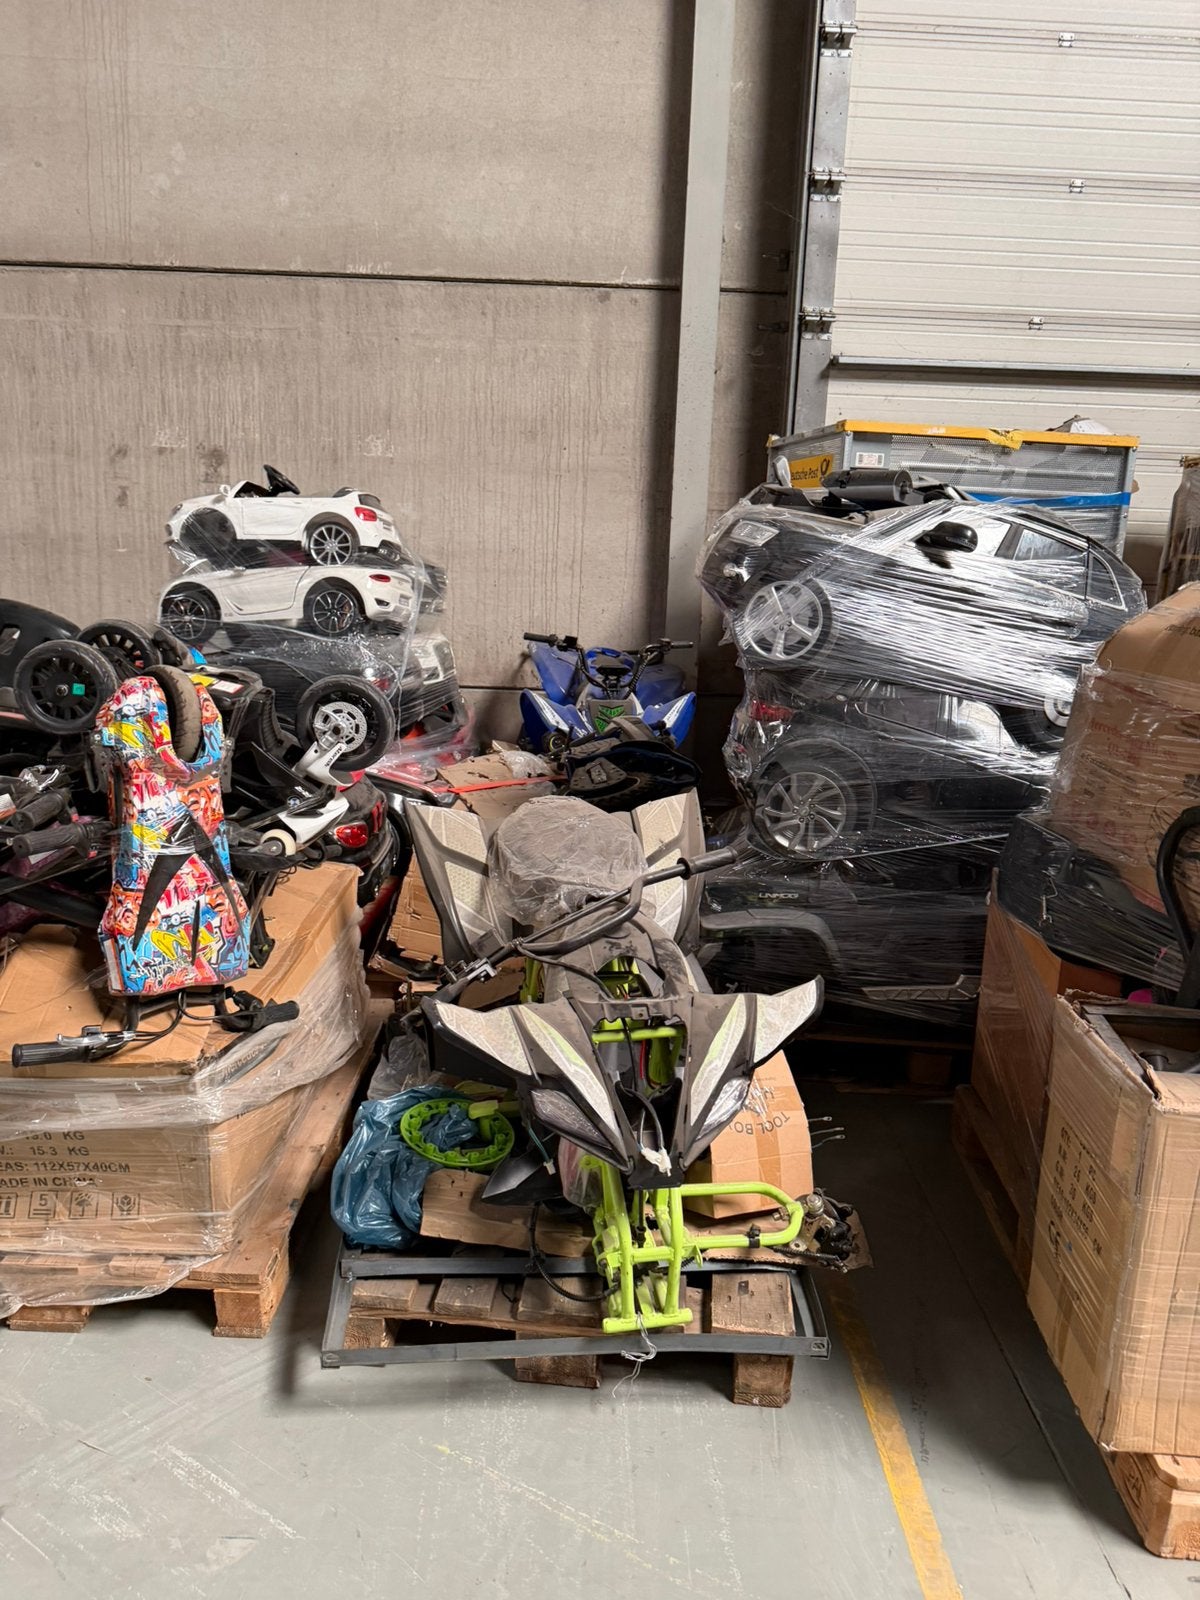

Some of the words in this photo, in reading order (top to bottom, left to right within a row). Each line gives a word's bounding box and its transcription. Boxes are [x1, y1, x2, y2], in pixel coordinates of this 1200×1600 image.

[791, 470, 808, 481] eutsche
[729, 1121, 754, 1135] BO
[756, 1111, 790, 1135] TOOL
[63, 1131, 85, 1141] KG
[29, 1146, 58, 1156] 15.3
[67, 1146, 90, 1156] KG
[33, 1161, 131, 1173] 112X57X40CM
[34, 1177, 48, 1187] IN
